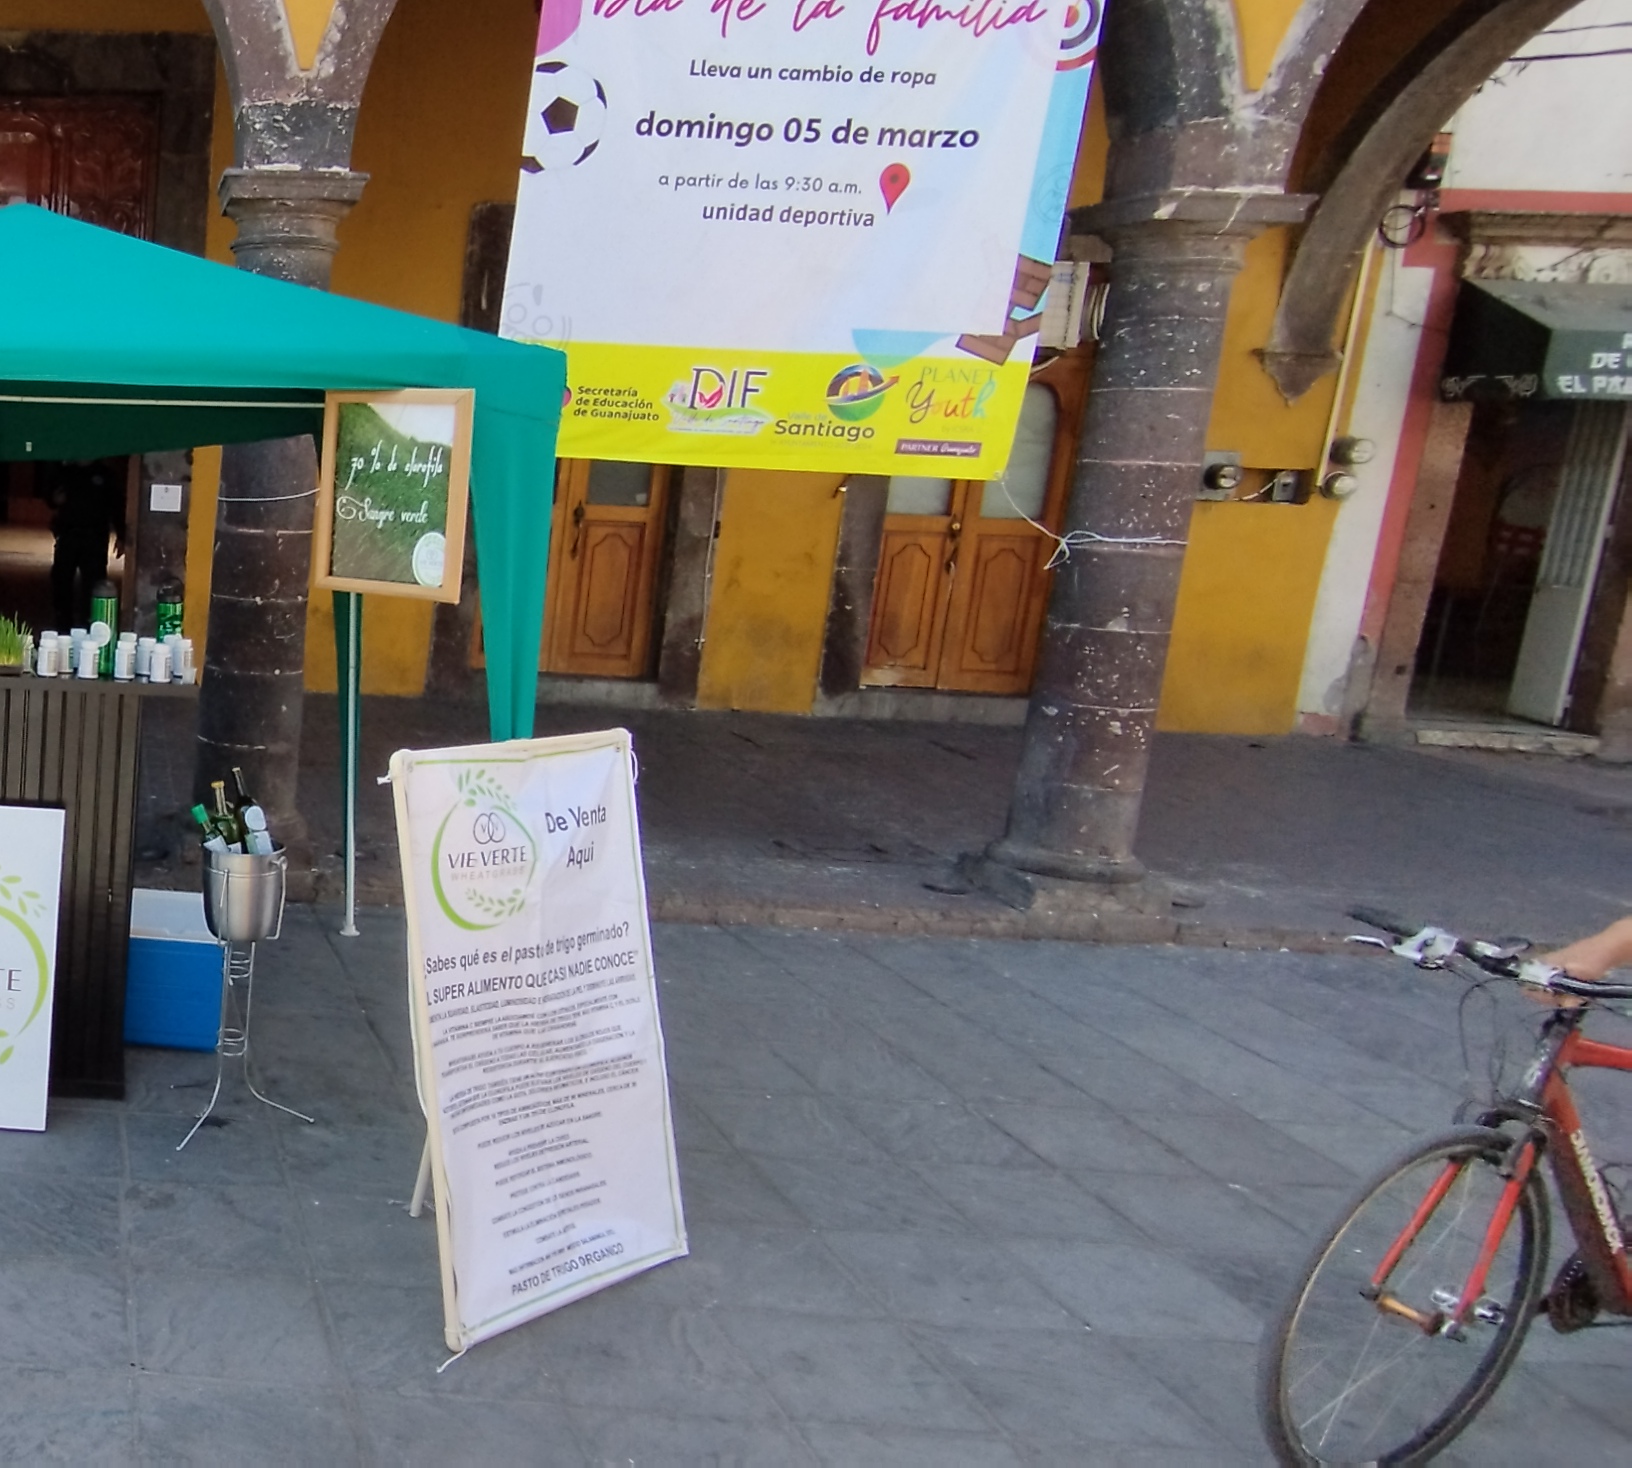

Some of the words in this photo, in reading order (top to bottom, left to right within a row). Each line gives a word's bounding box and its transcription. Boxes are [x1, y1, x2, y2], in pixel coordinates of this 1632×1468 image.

[689, 59, 742, 79] Lleva
[747, 65, 772, 80] un
[778, 64, 854, 83] cambio
[859, 66, 885, 84] de
[890, 70, 937, 89] ropa
[635, 110, 774, 147] domingo
[783, 116, 822, 144] 05
[831, 118, 869, 146] de
[877, 125, 981, 149] marzo
[658, 174, 670, 187] a
[674, 171, 724, 191] partir
[728, 172, 749, 190] de
[754, 173, 779, 191] las
[784, 175, 823, 193] 9:30
[828, 180, 863, 195] a.m.
[702, 203, 774, 223] unidad
[779, 205, 875, 228] deportiva
[1590, 352, 1622, 369] DE
[577, 386, 638, 398] Secretaría
[688, 367, 768, 410] DIF
[1558, 375, 1587, 393] EL
[575, 396, 590, 406] de
[592, 397, 654, 410] Educación
[906, 379, 997, 424] Youth
[573, 407, 588, 417] de
[590, 408, 660, 422] Guanajuato
[774, 419, 875, 443] Santiago
[401, 501, 429, 524] verde
[545, 812, 568, 834] De
[568, 804, 607, 829] Venta
[448, 851, 476, 869] VIE
[481, 845, 528, 867] VERTE
[459, 948, 480, 972] qué
[482, 949, 497, 964] es
[501, 946, 512, 962] el
[546, 941, 555, 957] de
[556, 935, 575, 955] trigo
[576, 921, 629, 952] germinado?
[433, 982, 465, 1005] SUPER
[467, 974, 523, 997] ALIMENTO
[525, 971, 548, 989] QUE
[548, 965, 567, 984] CASI
[568, 958, 593, 979] NADIE
[511, 1275, 540, 1295] PASTO
[540, 1269, 552, 1285] DE
[551, 1258, 579, 1278] TRIGO
